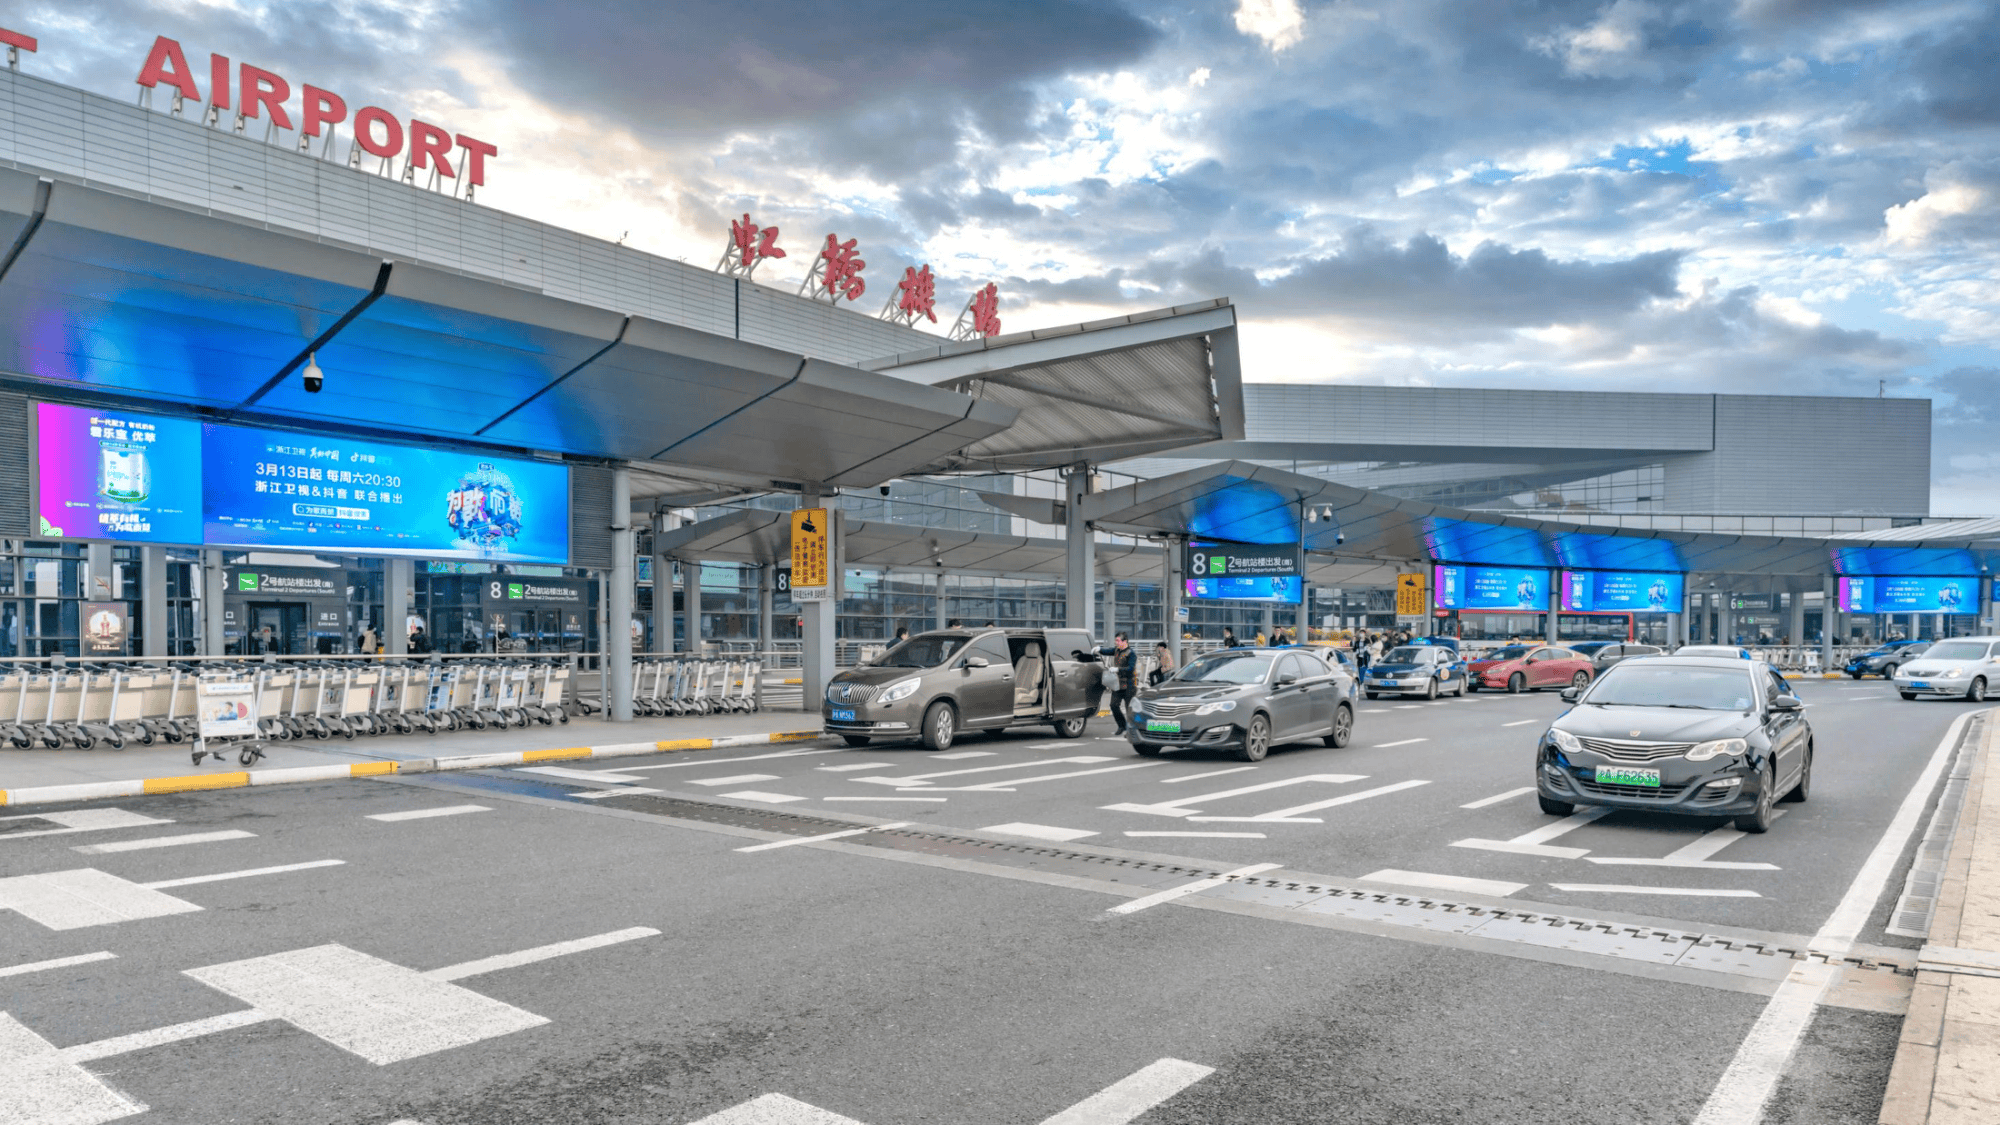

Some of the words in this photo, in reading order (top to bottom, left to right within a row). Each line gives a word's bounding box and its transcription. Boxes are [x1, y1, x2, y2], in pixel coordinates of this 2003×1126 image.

[136, 35, 498, 187] AIRPORT
[255, 461, 323, 481] 3月13日起
[326, 468, 401, 488] 每周六20:30
[254, 480, 349, 500] 浙江卫视&抖音
[353, 488, 404, 505] 联合播出
[1192, 552, 1206, 575] 8
[490, 581, 502, 599] 8
[778, 573, 787, 591] 8
[1730, 598, 1737, 610] 6
